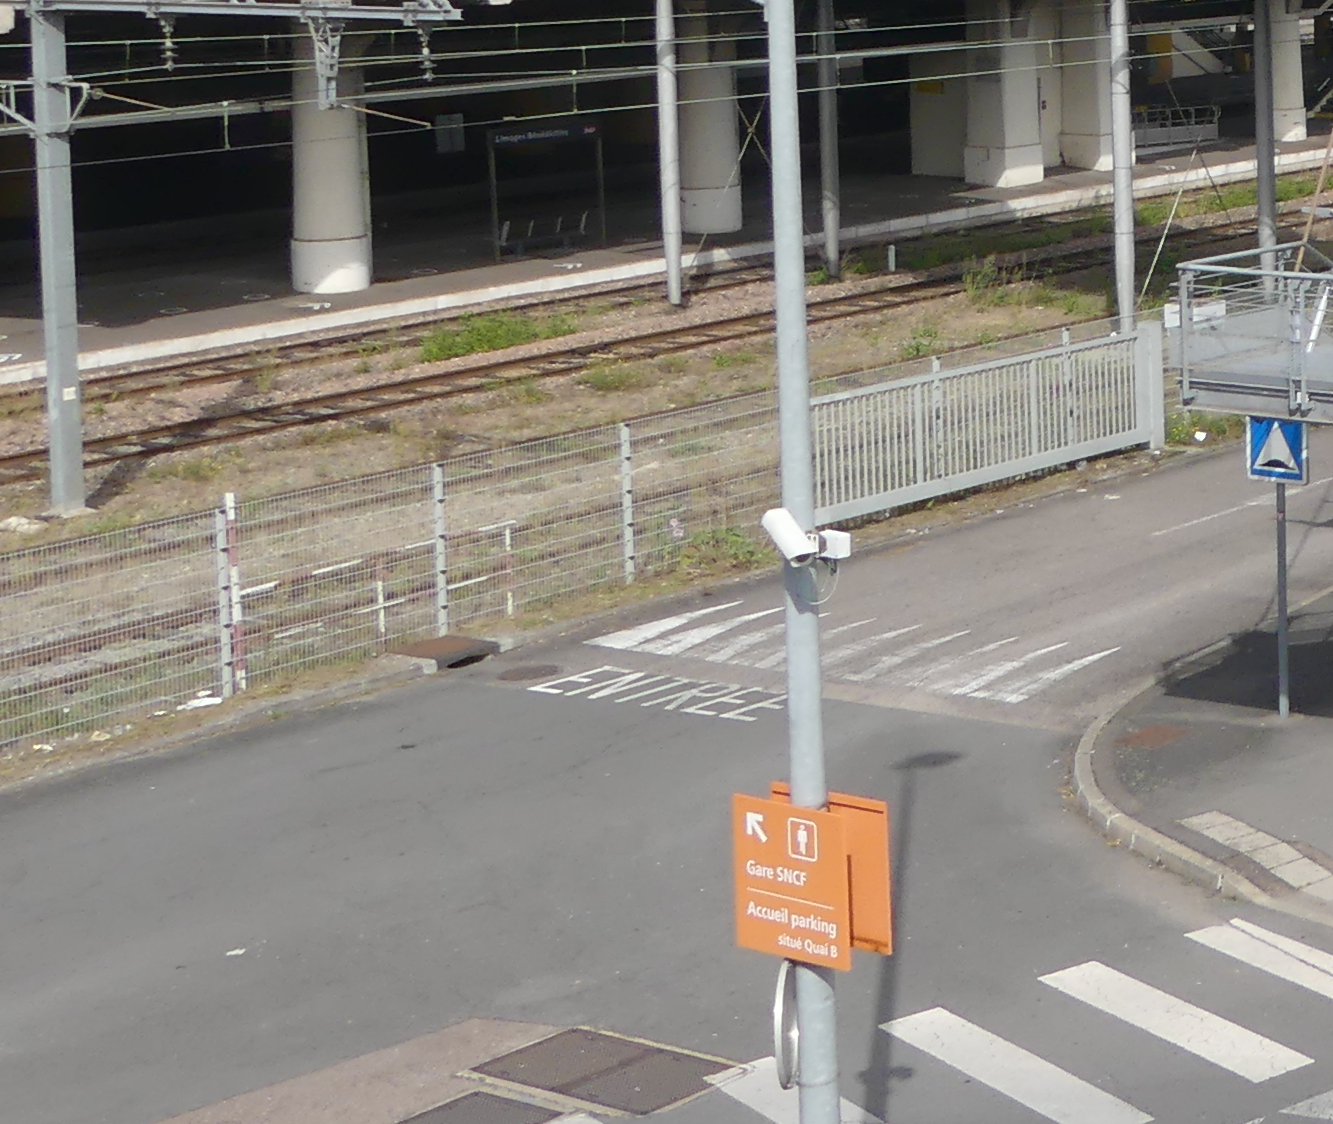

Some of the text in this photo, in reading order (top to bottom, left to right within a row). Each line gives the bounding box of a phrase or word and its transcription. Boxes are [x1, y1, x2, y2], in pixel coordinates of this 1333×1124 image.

[745, 859, 807, 887] Gare SNCF
[746, 901, 837, 939] Accueil parking
[777, 932, 839, 958] situé Quai B
